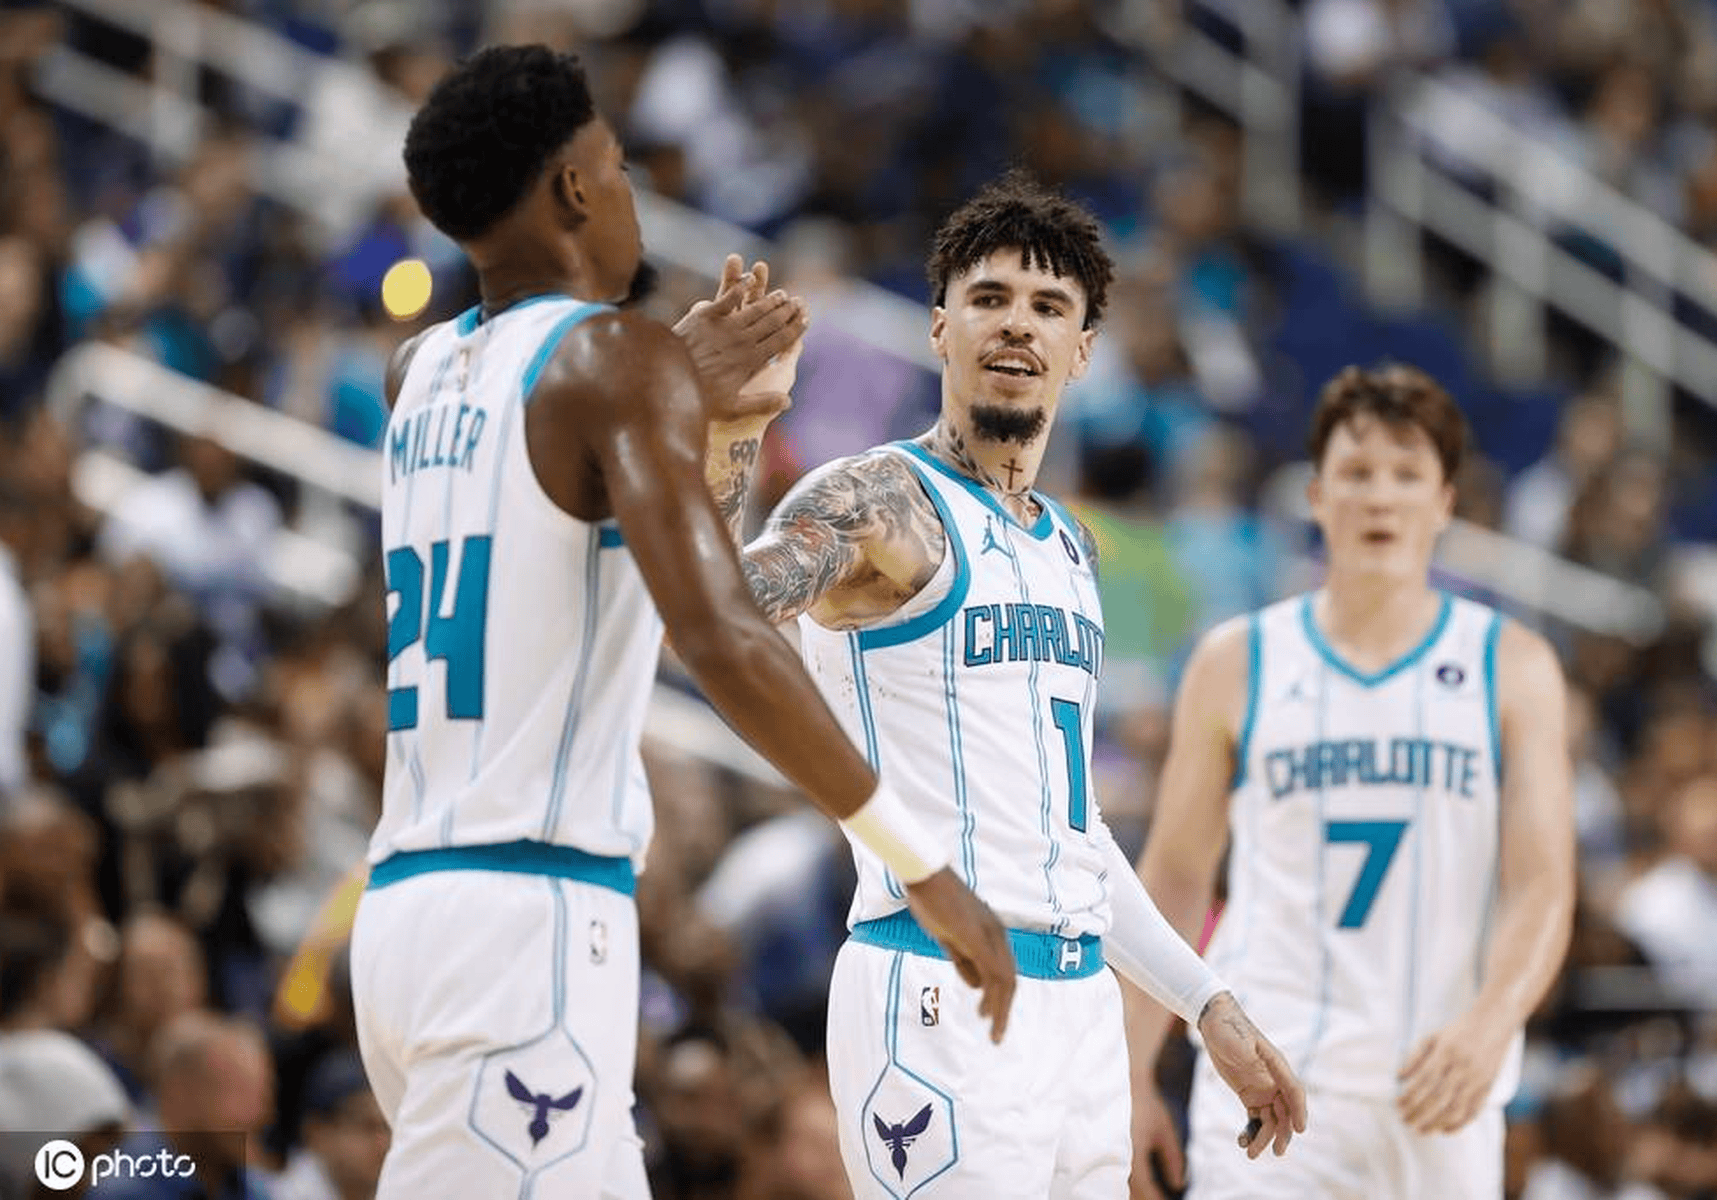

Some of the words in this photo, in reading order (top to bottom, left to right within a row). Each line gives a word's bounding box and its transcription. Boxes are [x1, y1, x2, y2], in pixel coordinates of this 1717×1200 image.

[389, 403, 487, 485] MILLER
[386, 535, 493, 731] 24
[1050, 696, 1087, 833] 1
[1265, 738, 1480, 799] CHARLOTTE
[1325, 819, 1411, 929] 7
